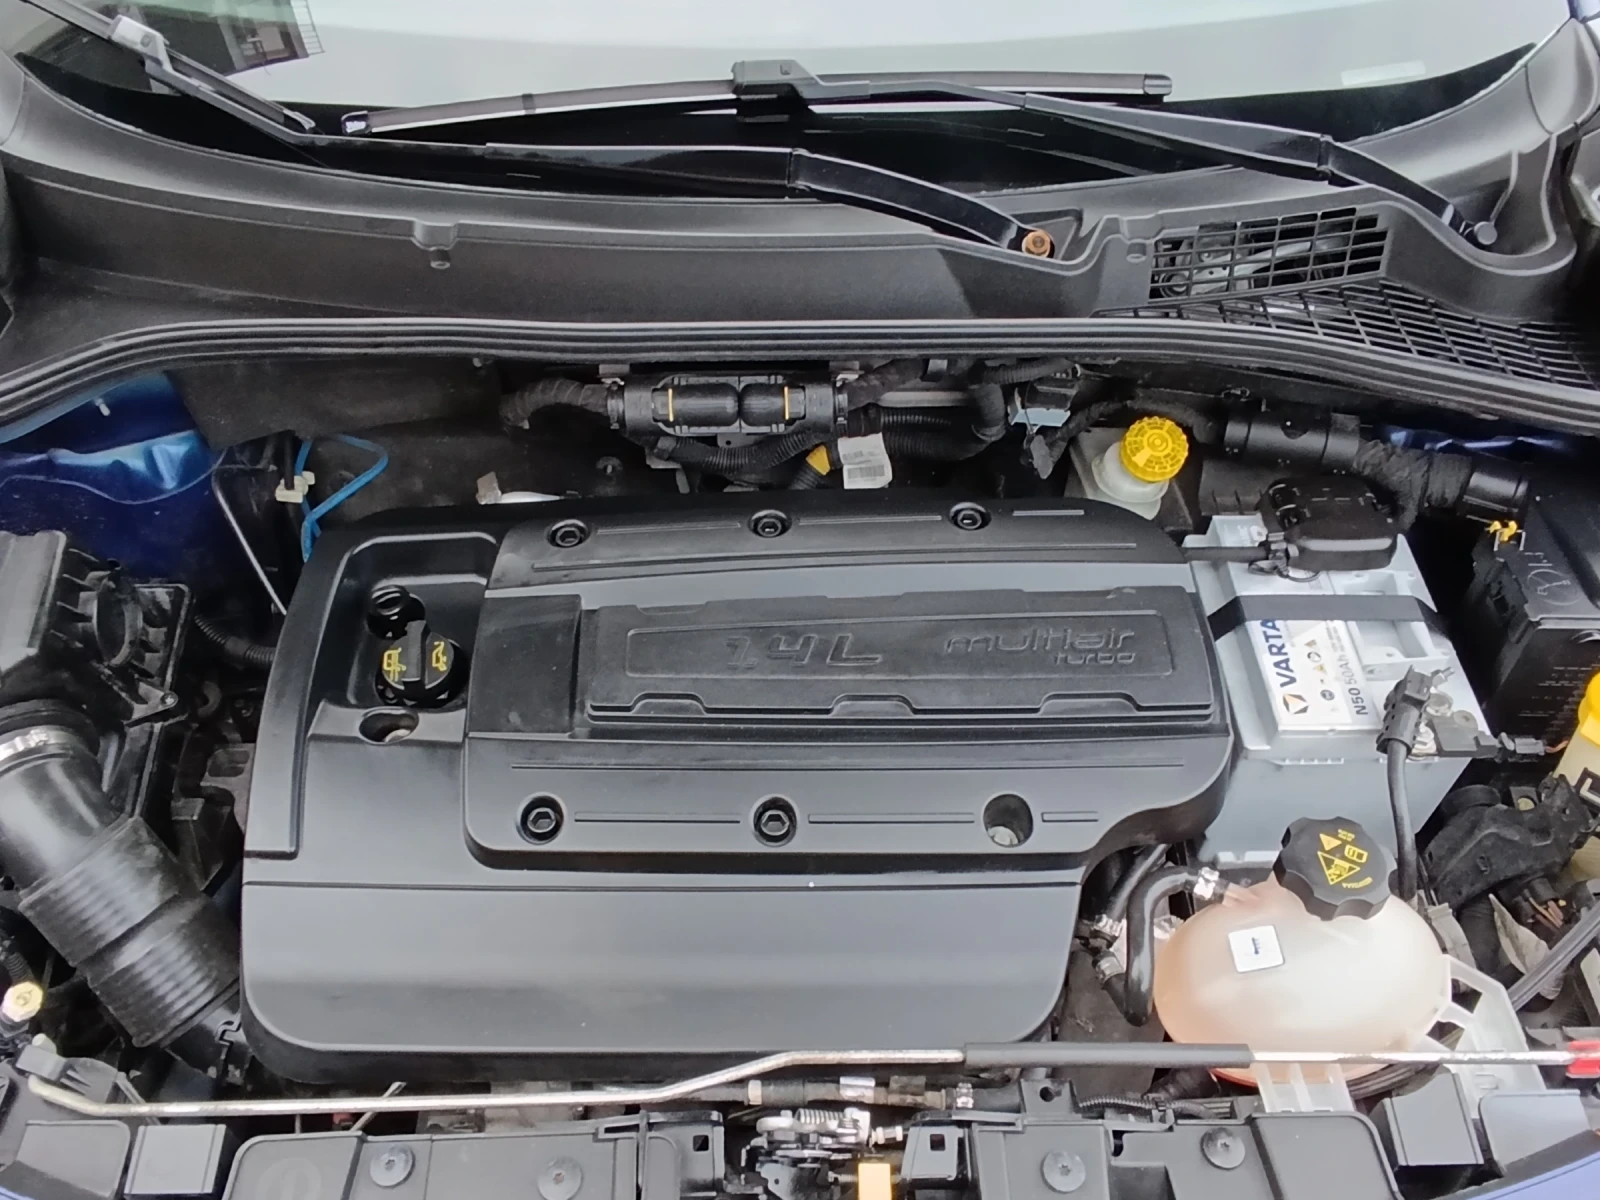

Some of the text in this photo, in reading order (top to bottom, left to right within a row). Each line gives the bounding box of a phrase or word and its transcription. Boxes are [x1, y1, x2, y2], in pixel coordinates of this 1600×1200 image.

[944, 627, 1135, 653] multiair
[1260, 619, 1297, 688] VARTA
[1055, 651, 1136, 665] turbo
[1348, 687, 1369, 715] N50
